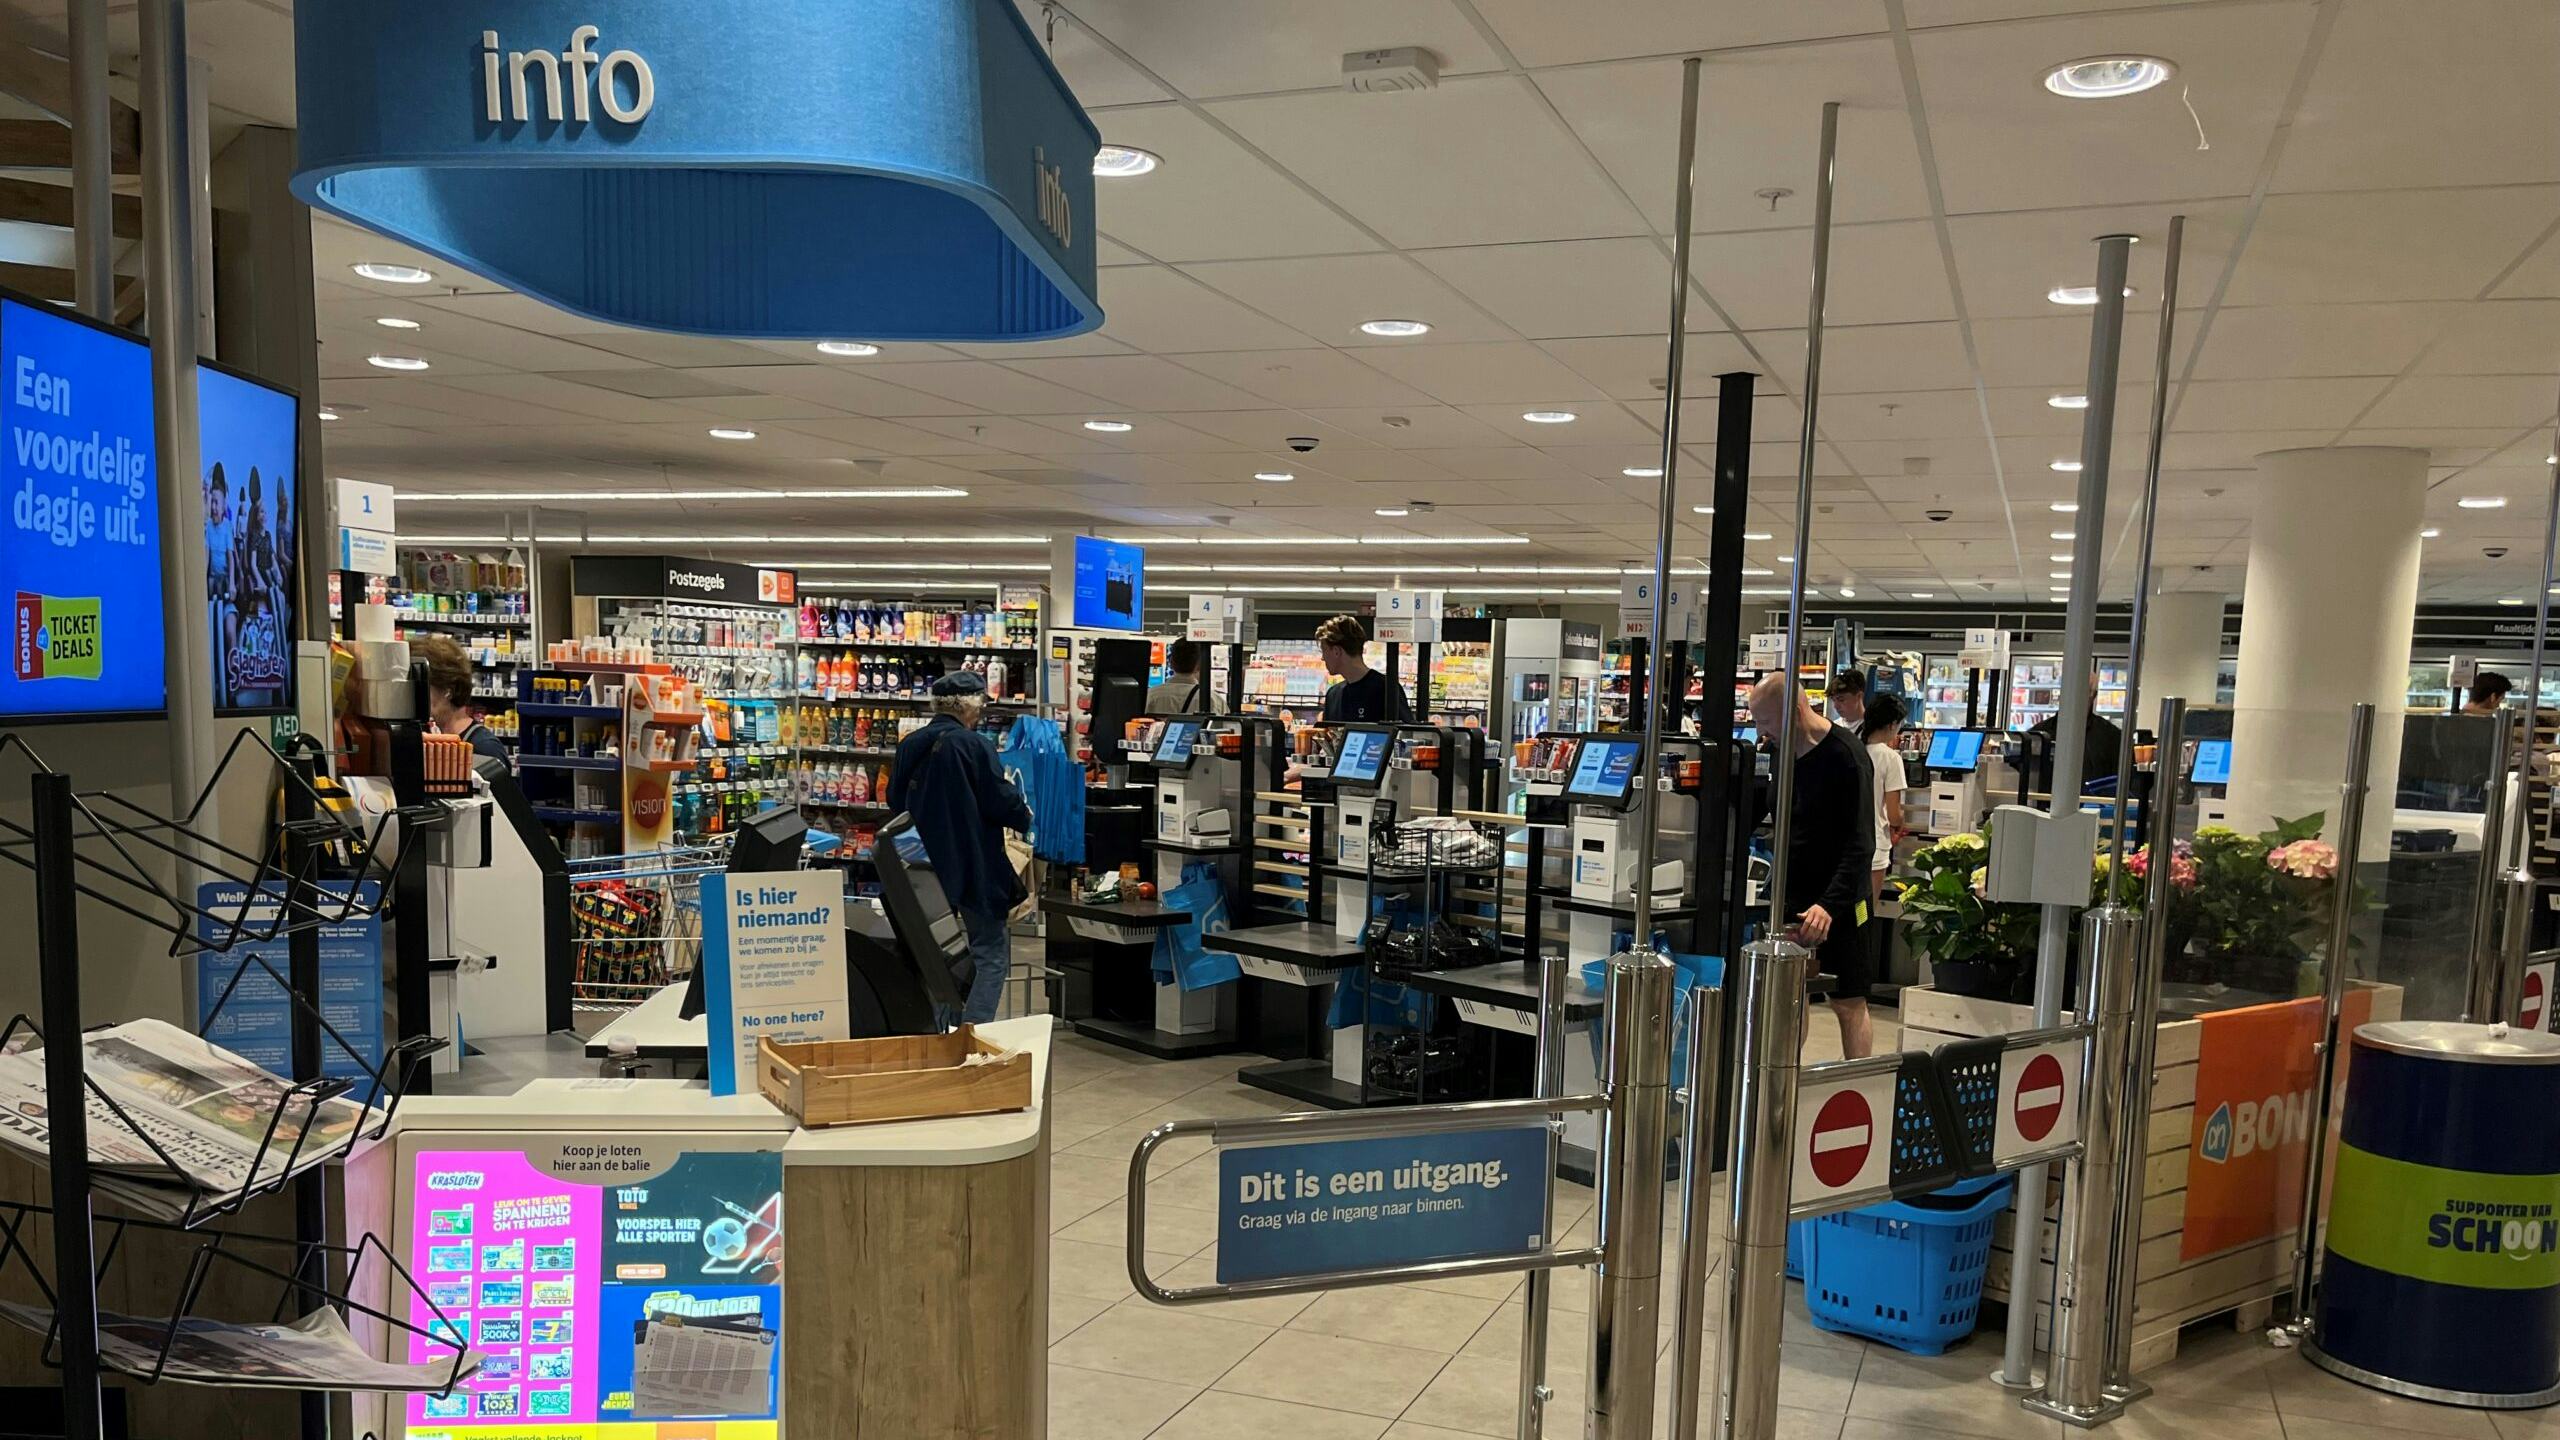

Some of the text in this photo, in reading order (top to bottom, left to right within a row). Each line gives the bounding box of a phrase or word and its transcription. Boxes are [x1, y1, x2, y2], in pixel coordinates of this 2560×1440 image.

[483, 25, 655, 123] info
[1033, 146, 1072, 248] info
[16, 355, 70, 416] Een
[14, 427, 146, 499] voordelig
[14, 477, 145, 547] dagje uit.
[362, 495, 372, 513] 1
[669, 570, 725, 591] Postzegels
[1638, 585, 1647, 598] 6
[1670, 592, 1678, 605] 9
[1203, 601, 1210, 612] 4
[1392, 598, 1399, 609] 5
[1415, 598, 1421, 609] 8
[51, 615, 96, 636] TICKET
[20, 607, 31, 673] BONUS
[53, 638, 94, 659] DEALS
[1758, 639, 1768, 647] 12
[275, 715, 299, 737] AED
[216, 891, 268, 903] Welkm
[736, 887, 797, 906] Is hier
[738, 907, 830, 928] niemand?
[738, 937, 754, 945] Een
[757, 935, 799, 944] momentje
[754, 947, 783, 955] komen
[797, 944, 808, 953] bij
[742, 1010, 825, 1027] No one here?
[563, 1145, 641, 1158] Koop je loten
[553, 1160, 651, 1171] hier aan de balie
[431, 1174, 481, 1187] KRASLOTEN
[1240, 1159, 1509, 1203] Dit is een uitgang.
[494, 1195, 571, 1209] LEUK OM TE GEVEN
[616, 1189, 649, 1203] TOTO
[493, 1203, 571, 1221] SPANNEND
[1239, 1214, 1282, 1229] Graag
[1286, 1210, 1305, 1225] via
[1311, 1208, 1328, 1222] de
[1382, 1201, 1414, 1216] naar
[1416, 1198, 1465, 1213] binnen.
[2445, 1199, 2553, 1217] SUPPORTER VAN
[493, 1219, 511, 1231] OM
[513, 1218, 526, 1230] TE
[616, 1218, 701, 1230] VOORSPEL HIER
[616, 1231, 696, 1243] ALLE SPORTEN
[2427, 1213, 2559, 1253] SCHOON
